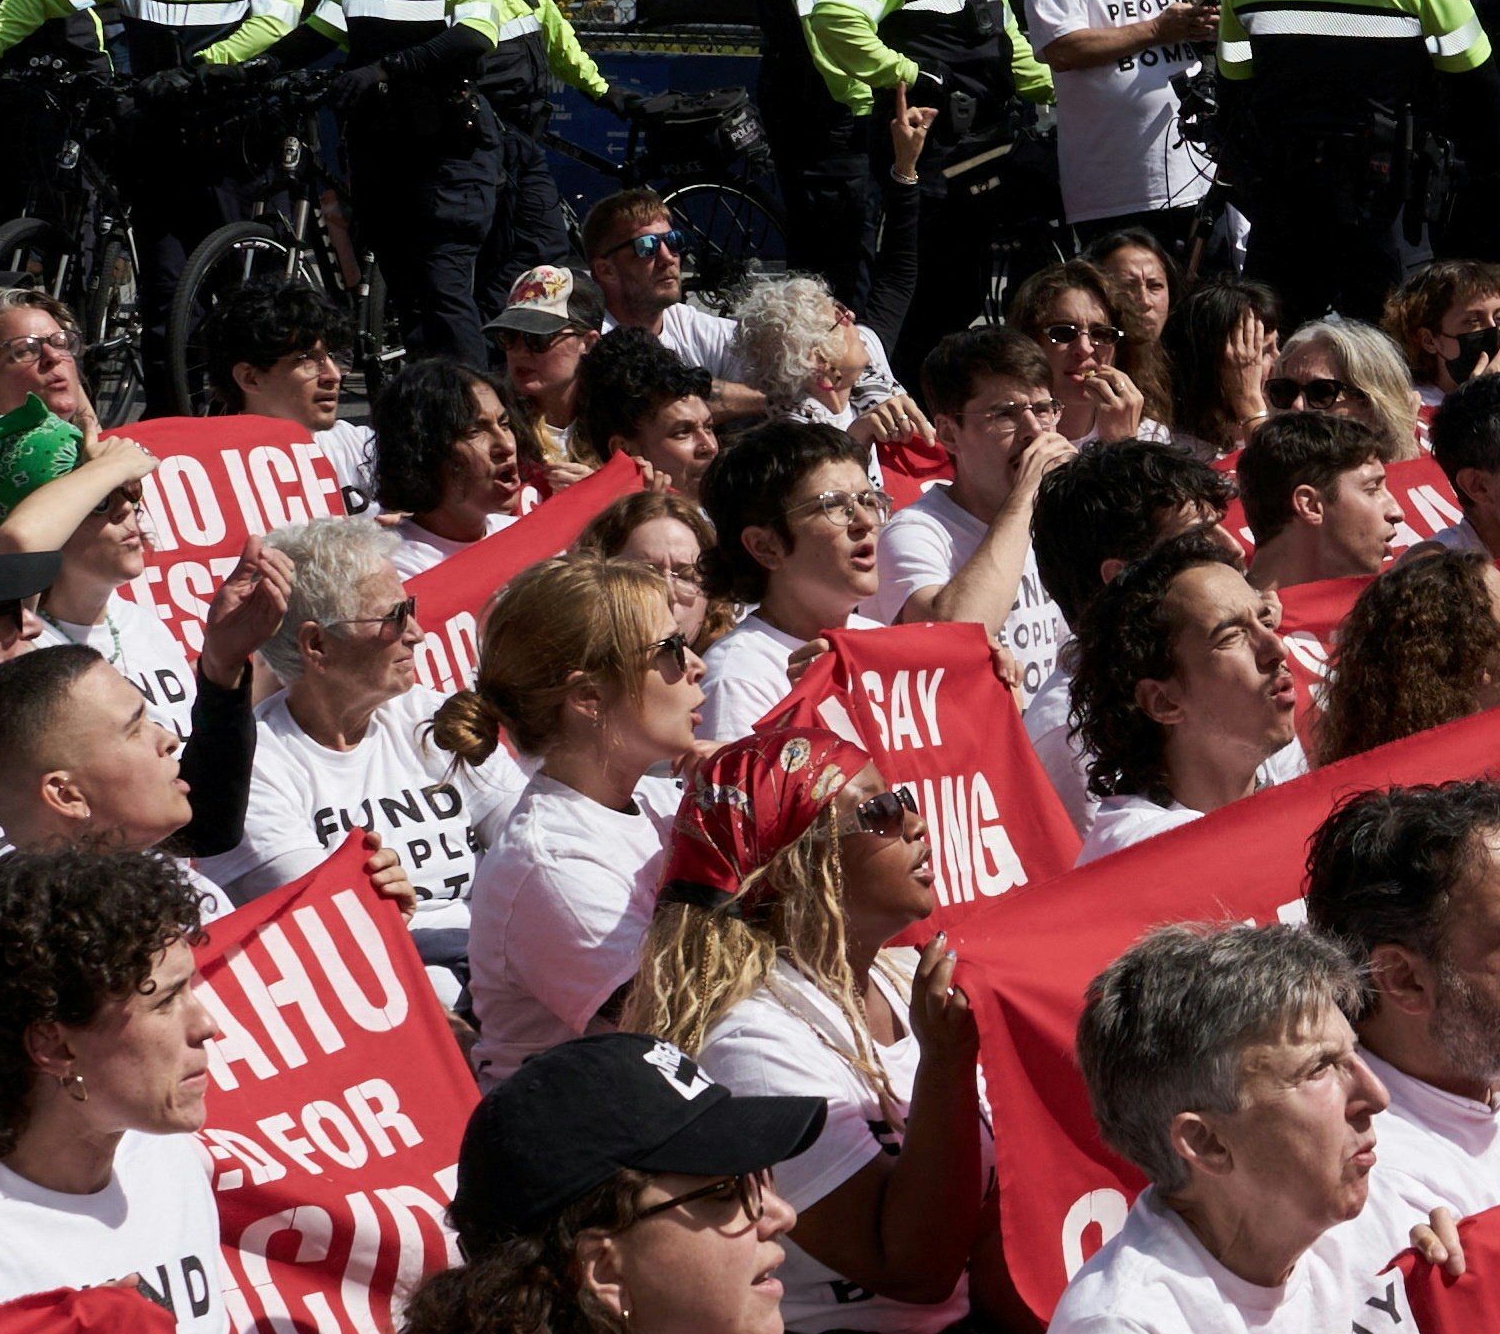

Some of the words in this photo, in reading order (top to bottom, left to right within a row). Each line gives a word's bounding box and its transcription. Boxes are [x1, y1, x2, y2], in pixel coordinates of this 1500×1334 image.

[1119, 42, 1200, 72] BOM
[236, 441, 346, 539] ICE
[998, 616, 1060, 650] EOPLE
[860, 667, 946, 752] SAY
[1022, 657, 1057, 697] OT
[313, 784, 463, 850] FUND
[256, 1079, 424, 1179] FOR
